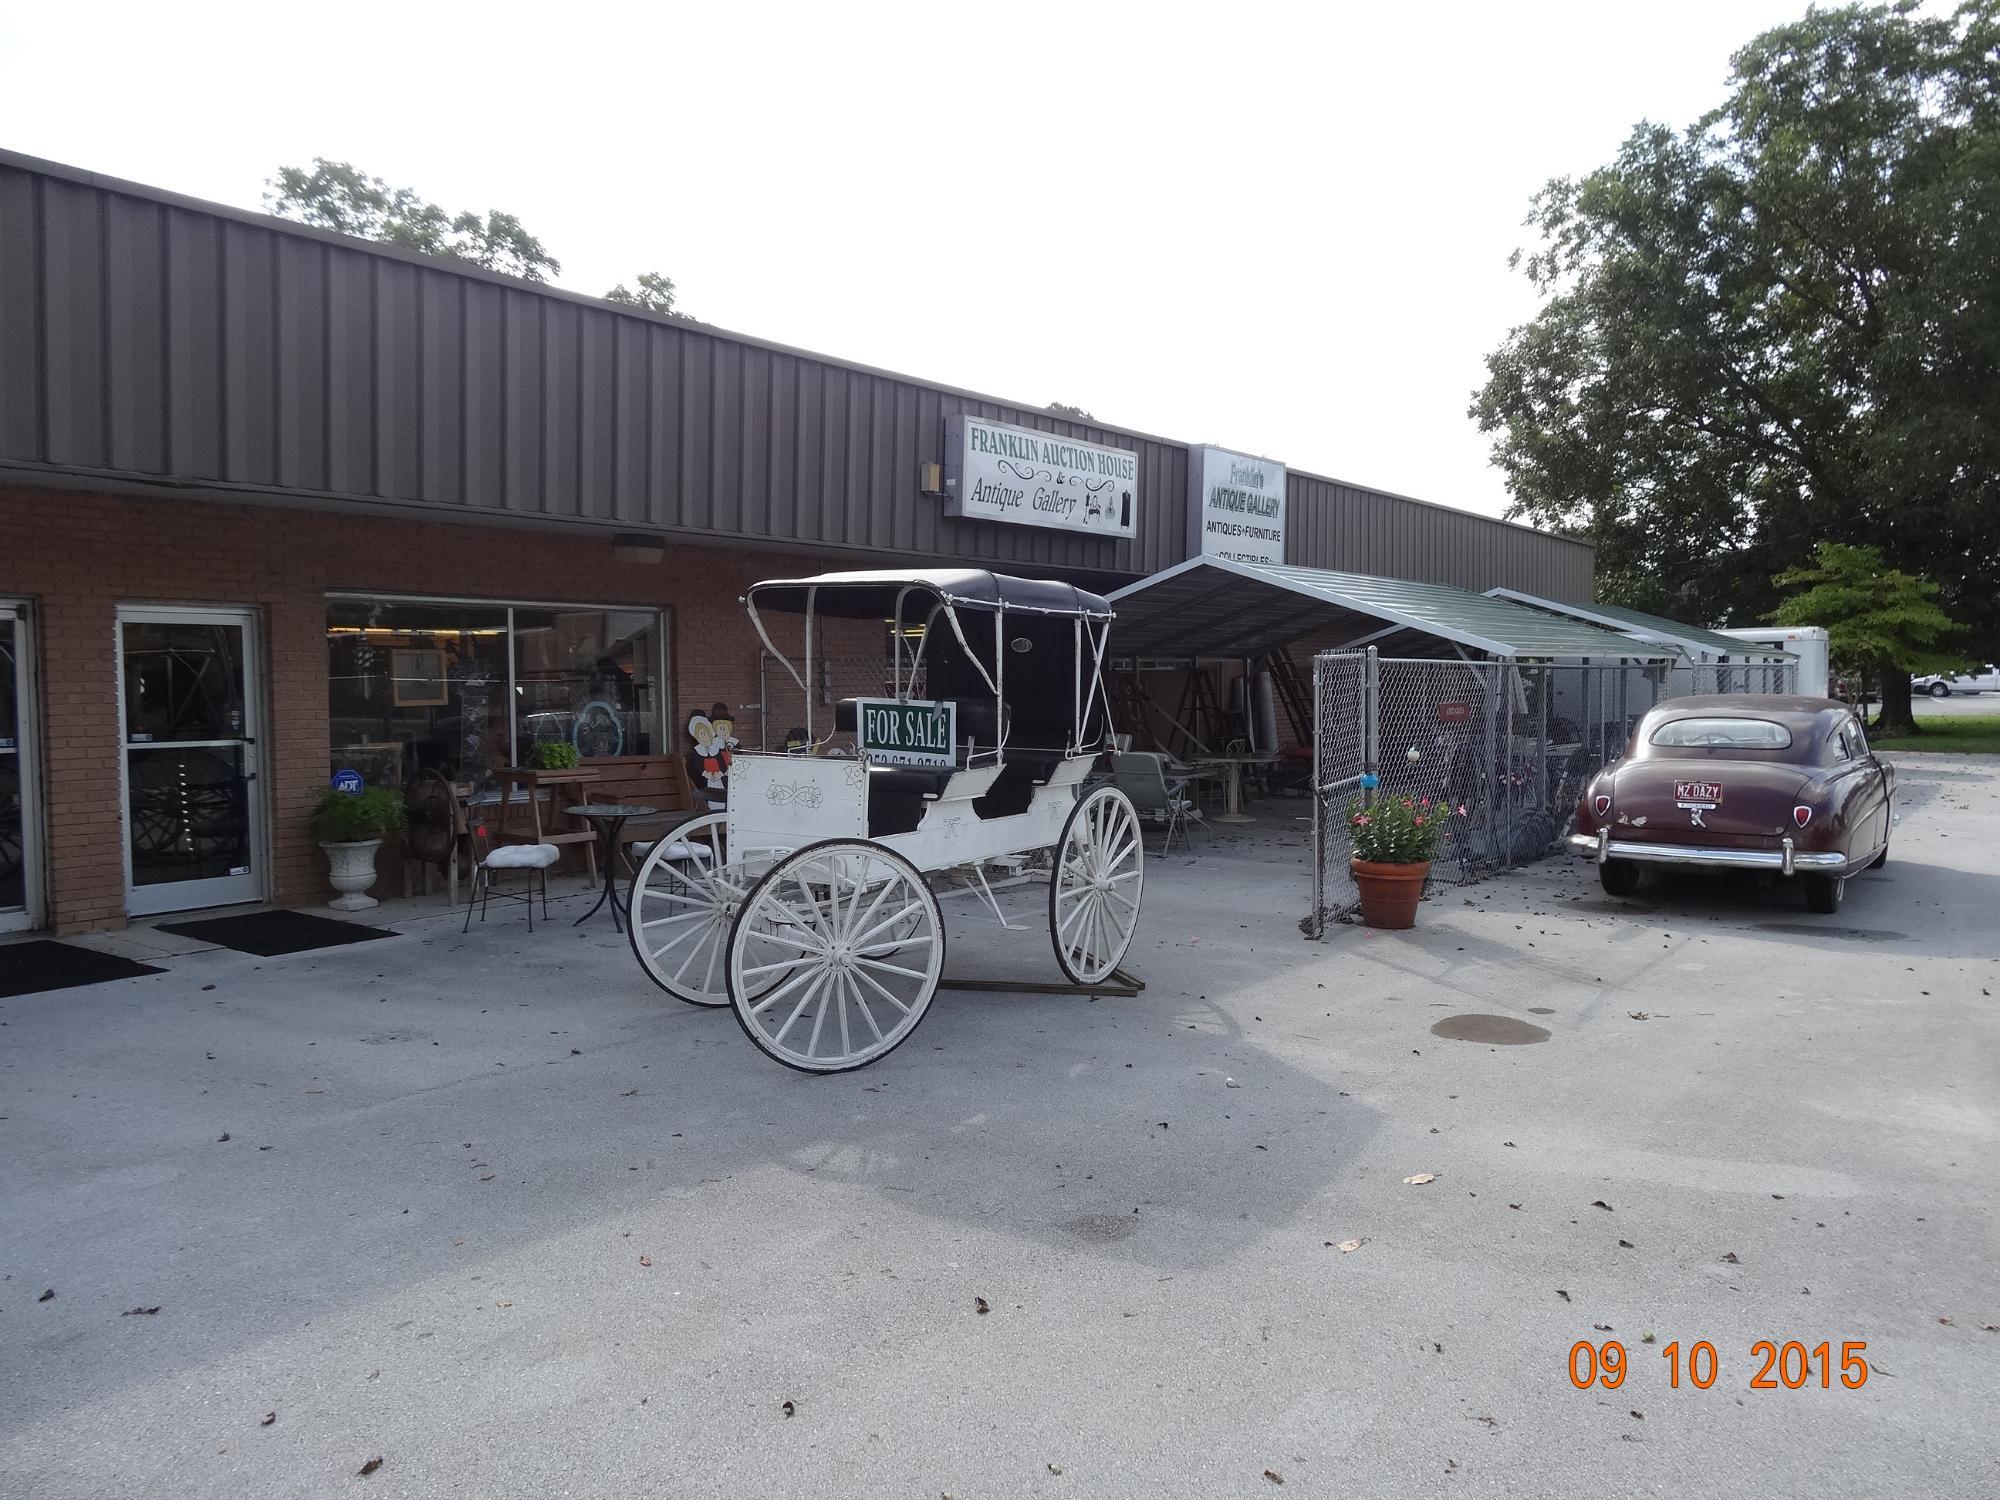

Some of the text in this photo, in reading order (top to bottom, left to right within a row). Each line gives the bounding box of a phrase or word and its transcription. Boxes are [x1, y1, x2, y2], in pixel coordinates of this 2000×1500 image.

[970, 426, 1134, 481] FRANKLIN AUCTION HOUSE
[1056, 471, 1066, 485] &
[970, 477, 1077, 520] Antique Gallery
[1208, 485, 1280, 519] ANTIQUE GALLERY
[866, 709, 947, 749] FOR SALE
[339, 779, 358, 792] ADT
[1677, 785, 1719, 797] MZ DAZY
